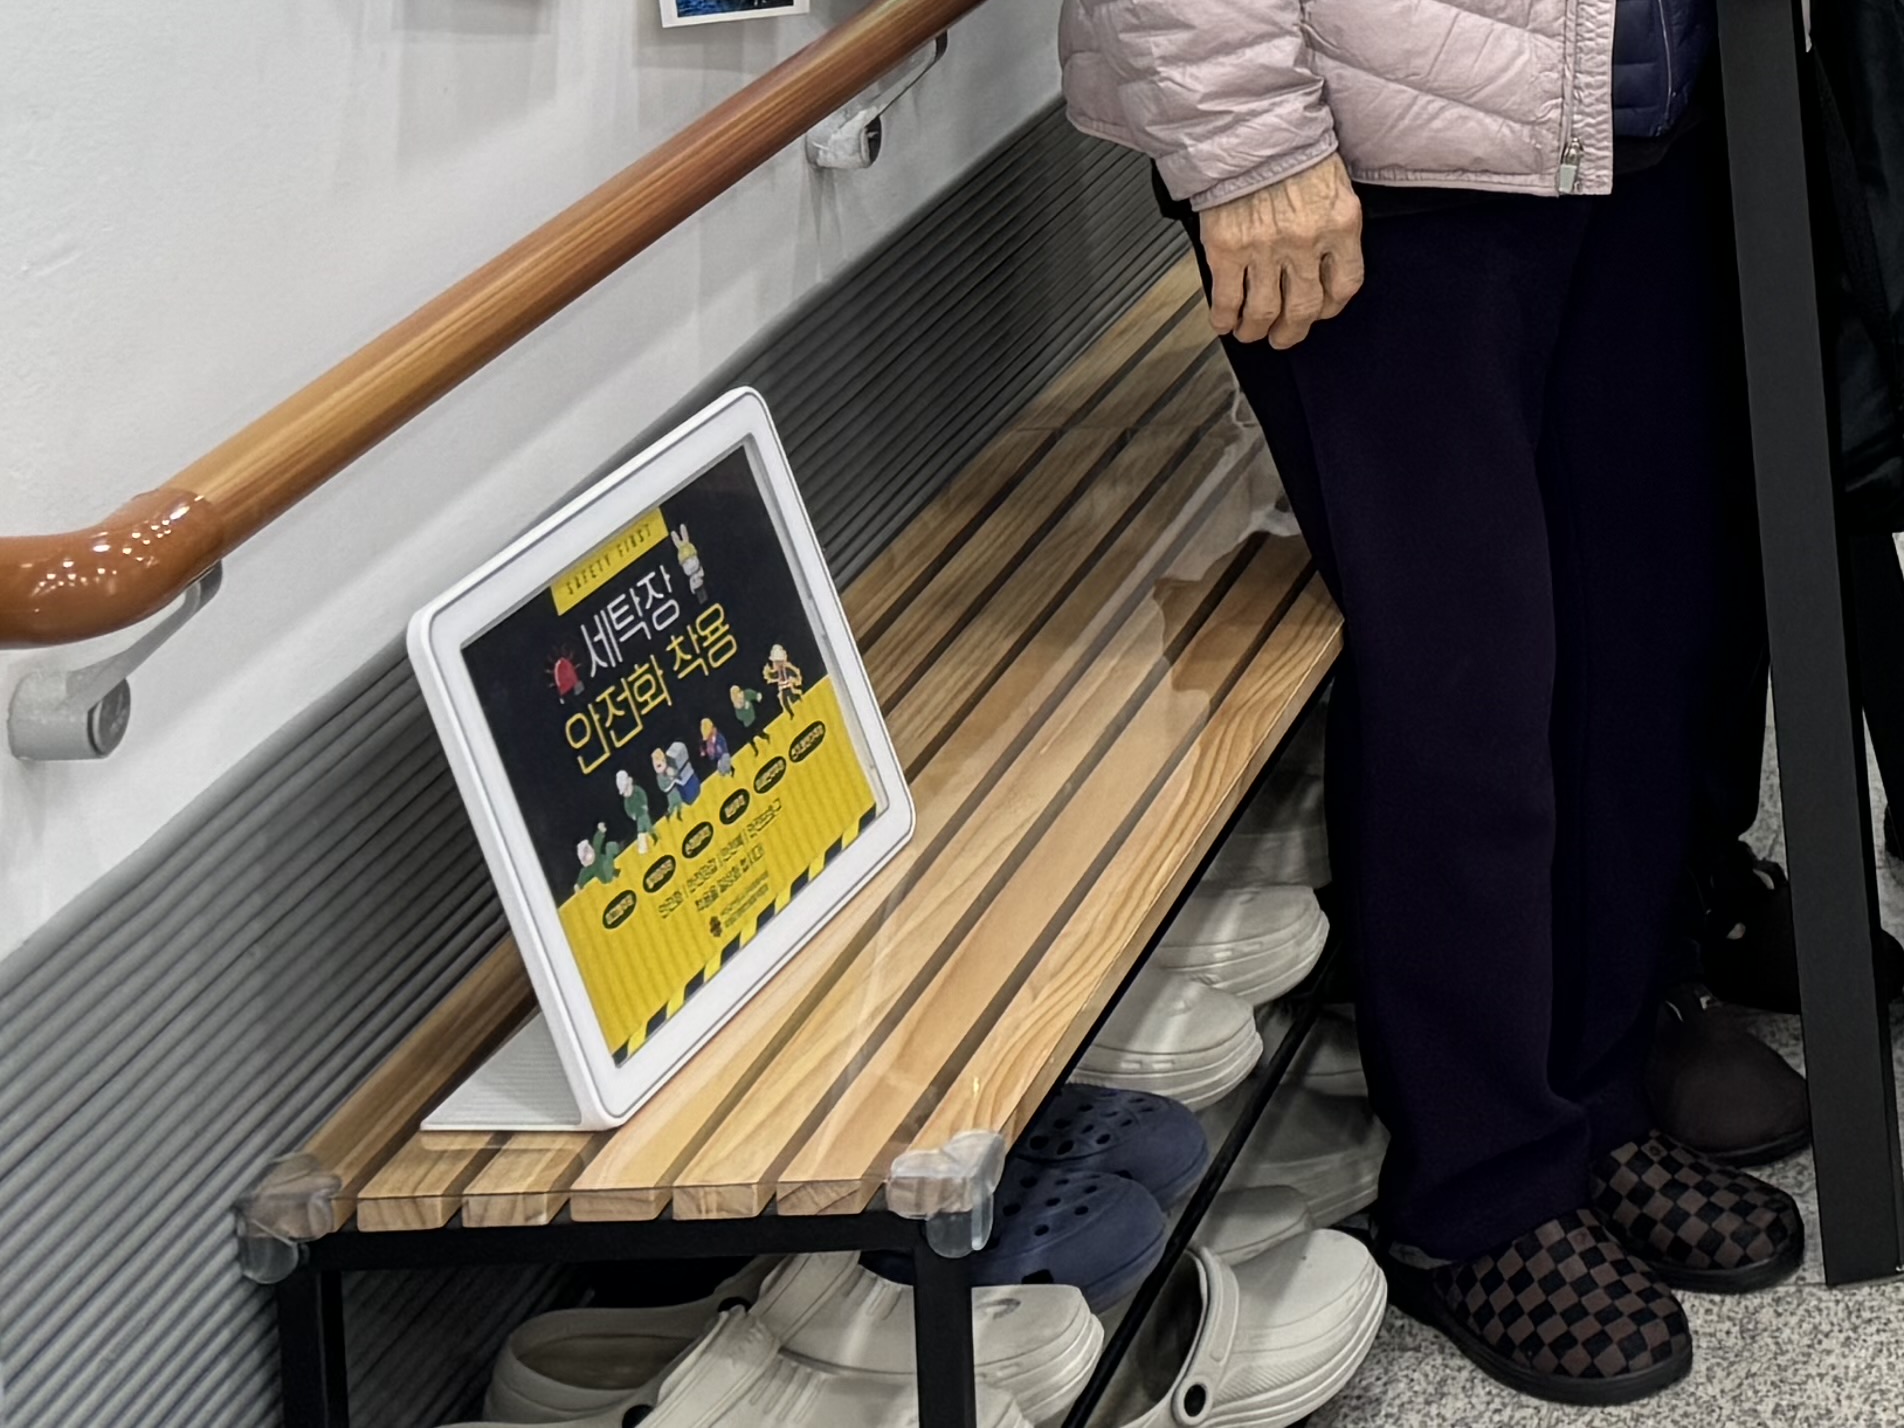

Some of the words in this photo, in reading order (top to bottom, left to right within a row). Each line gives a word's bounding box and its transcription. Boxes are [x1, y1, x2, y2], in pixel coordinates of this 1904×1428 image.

[564, 552, 612, 596] SAFETY
[615, 522, 652, 558] FIRST
[581, 565, 680, 678] 세탁장
[565, 654, 672, 774] 안전화
[666, 603, 738, 679] 착용
